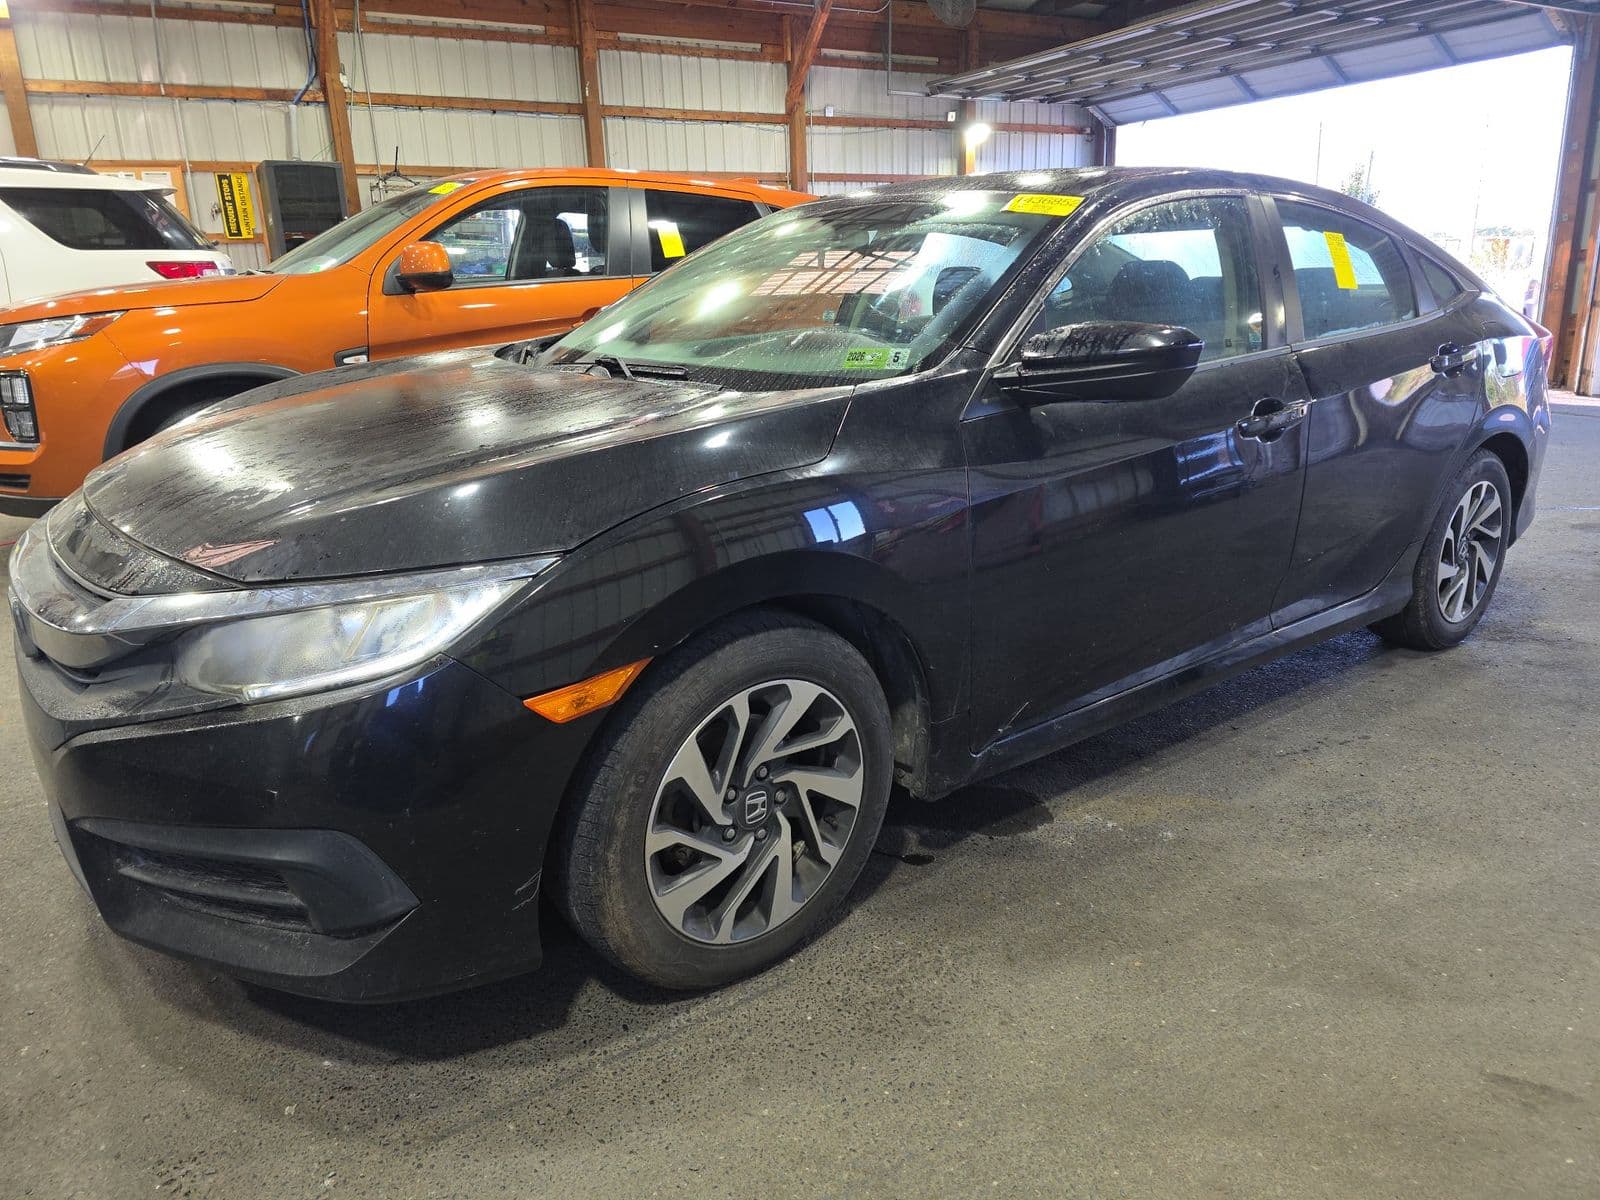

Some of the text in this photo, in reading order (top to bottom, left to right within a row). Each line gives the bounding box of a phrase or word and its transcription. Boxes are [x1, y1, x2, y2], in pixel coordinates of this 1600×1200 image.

[221, 178, 238, 234] FREQUENT STOPS
[236, 176, 252, 235] MAINTAIN DISTANCE
[893, 351, 901, 363] 5
